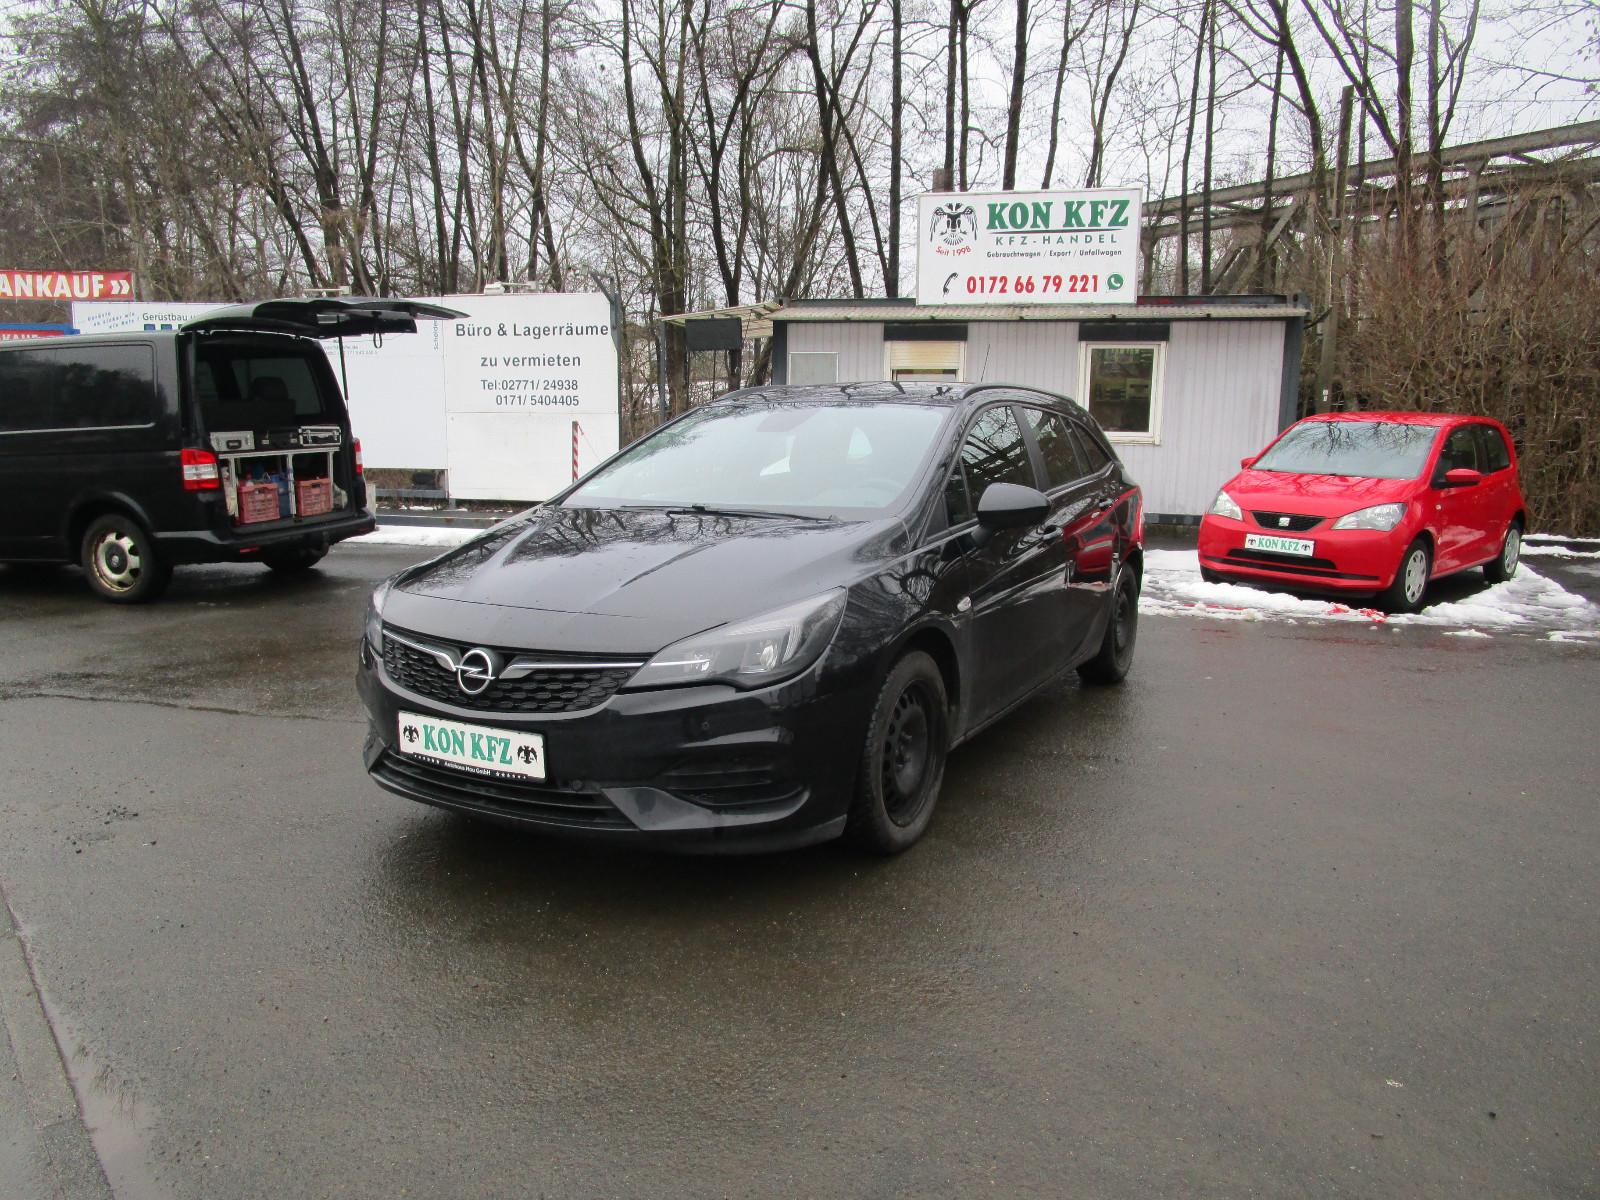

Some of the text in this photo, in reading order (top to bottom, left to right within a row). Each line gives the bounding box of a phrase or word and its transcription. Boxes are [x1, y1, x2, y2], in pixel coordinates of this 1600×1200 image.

[986, 199, 1131, 230] KON KFZ
[995, 234, 1118, 246] KFZ-HANDEL
[935, 245, 972, 257] Seit 1998
[986, 250, 1041, 259] Gebrauchtwagen
[1049, 250, 1072, 259] Export
[1079, 249, 1122, 258] Unfallwagen
[0, 274, 104, 298] ANKAUF
[966, 274, 1099, 294] 0172 66 79 221
[142, 312, 188, 321] Gerüstbau
[455, 322, 609, 340] Büro & Lagerräume
[480, 353, 581, 367] zu vermieten
[543, 379, 578, 391] 24938
[496, 395, 580, 406] 0171/ 5404405
[1257, 537, 1300, 552] KON KFZ
[422, 724, 513, 765] KON KFZ
